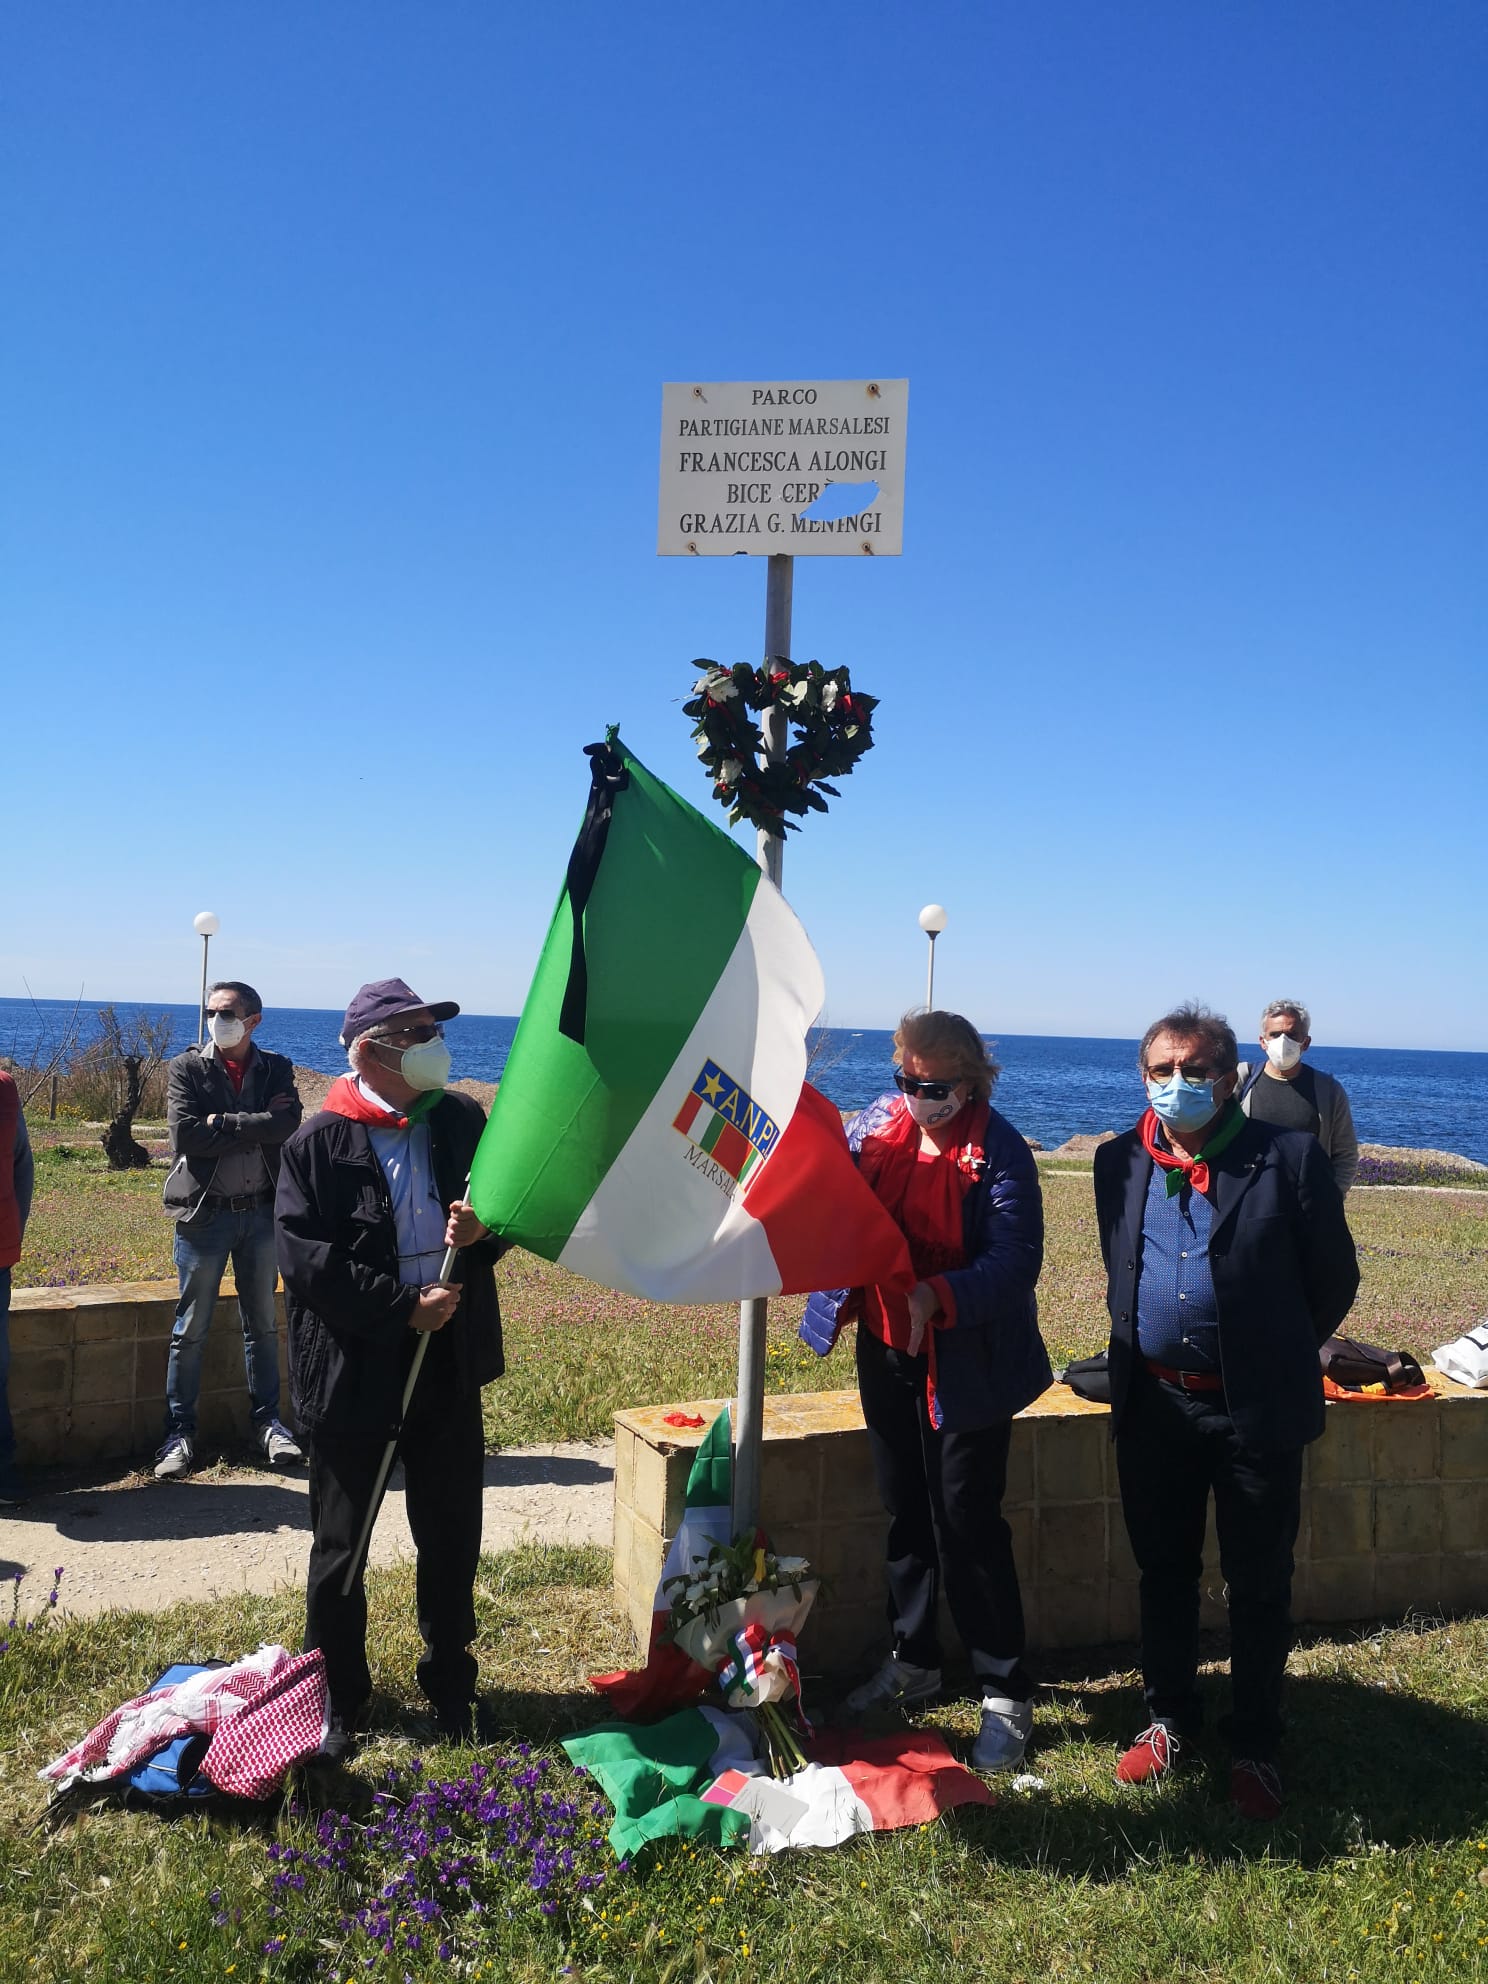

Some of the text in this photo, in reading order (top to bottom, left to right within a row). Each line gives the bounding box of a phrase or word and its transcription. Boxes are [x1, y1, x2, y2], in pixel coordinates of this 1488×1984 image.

[751, 389, 818, 405] PARCO
[679, 417, 890, 436] PARTIGIANE MARSALESI
[679, 451, 887, 472] FRANCESCA ALONGI
[727, 484, 771, 503] BICE
[679, 514, 761, 533] GRAZIA
[767, 514, 785, 533] G.
